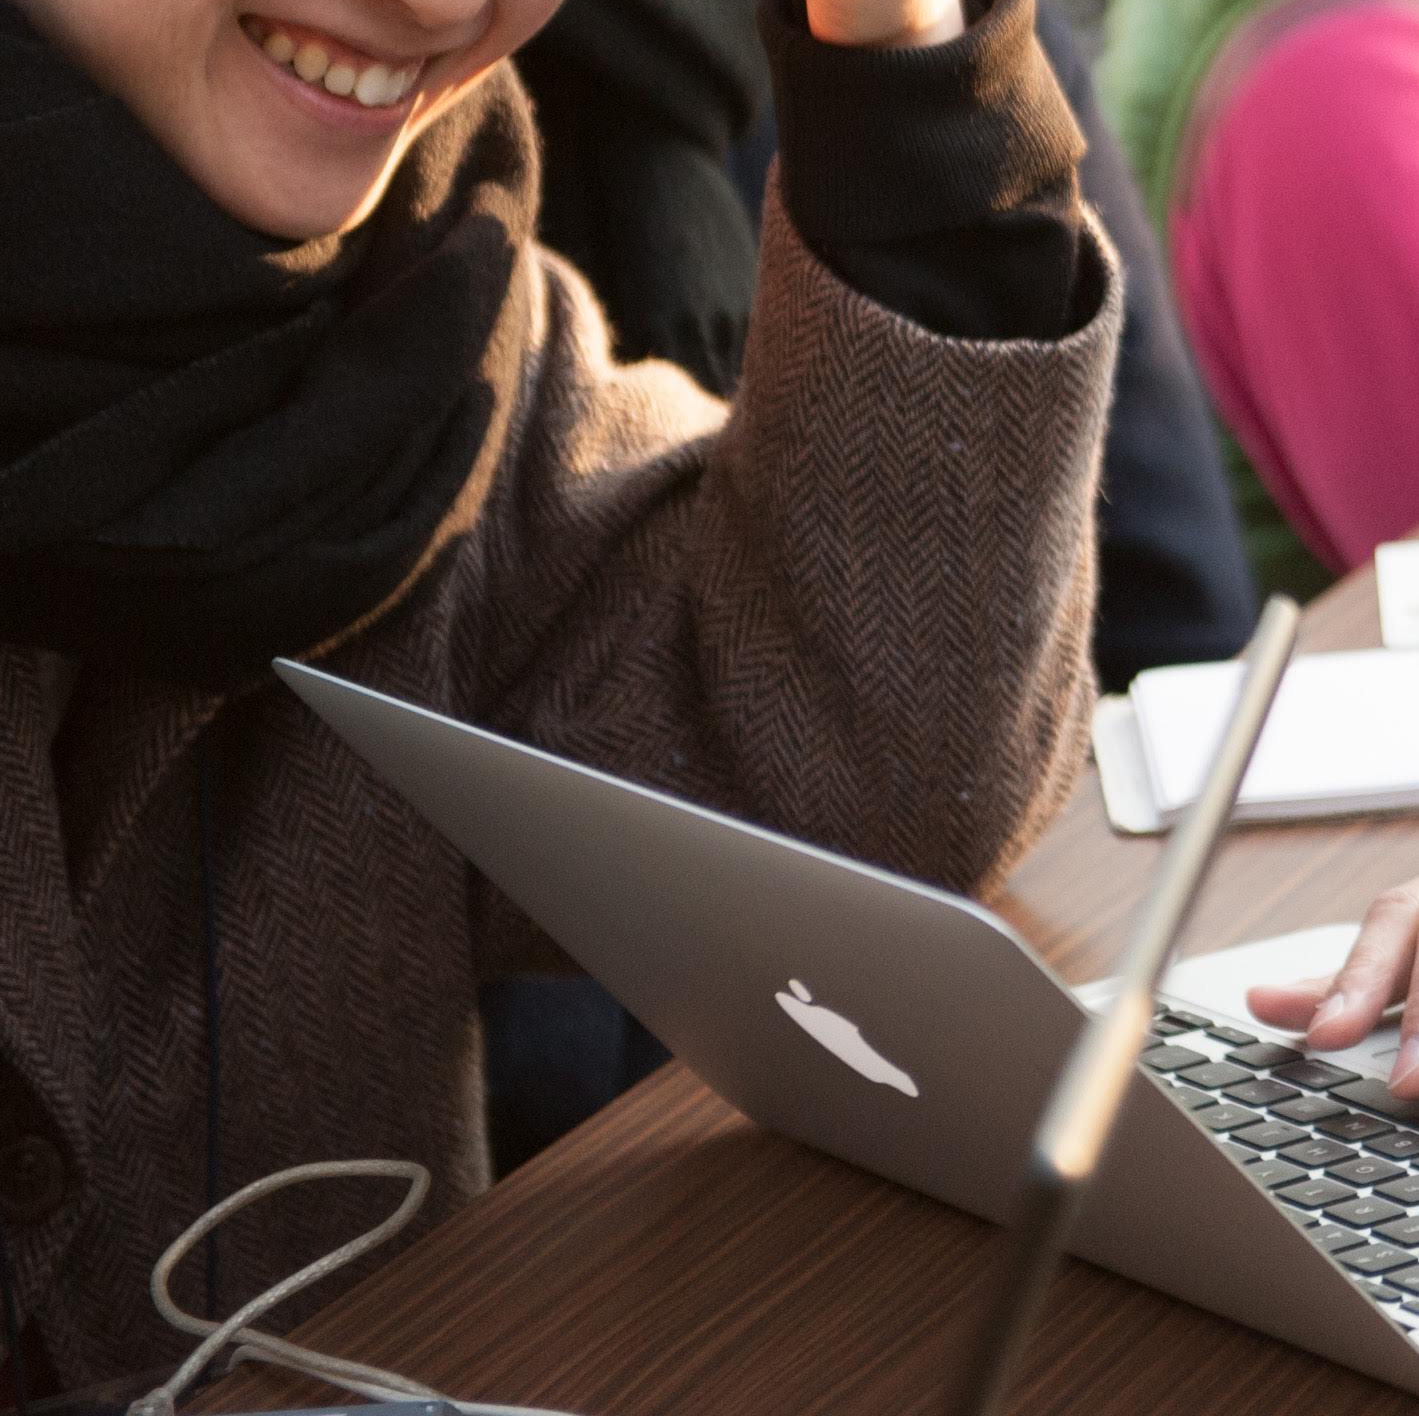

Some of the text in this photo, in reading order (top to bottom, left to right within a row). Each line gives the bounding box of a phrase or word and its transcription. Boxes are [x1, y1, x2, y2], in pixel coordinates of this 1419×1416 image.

[1394, 1140, 1413, 1149] B
[1306, 1146, 1329, 1156] H
[1354, 1166, 1375, 1174] G
[1354, 1205, 1375, 1215] R
